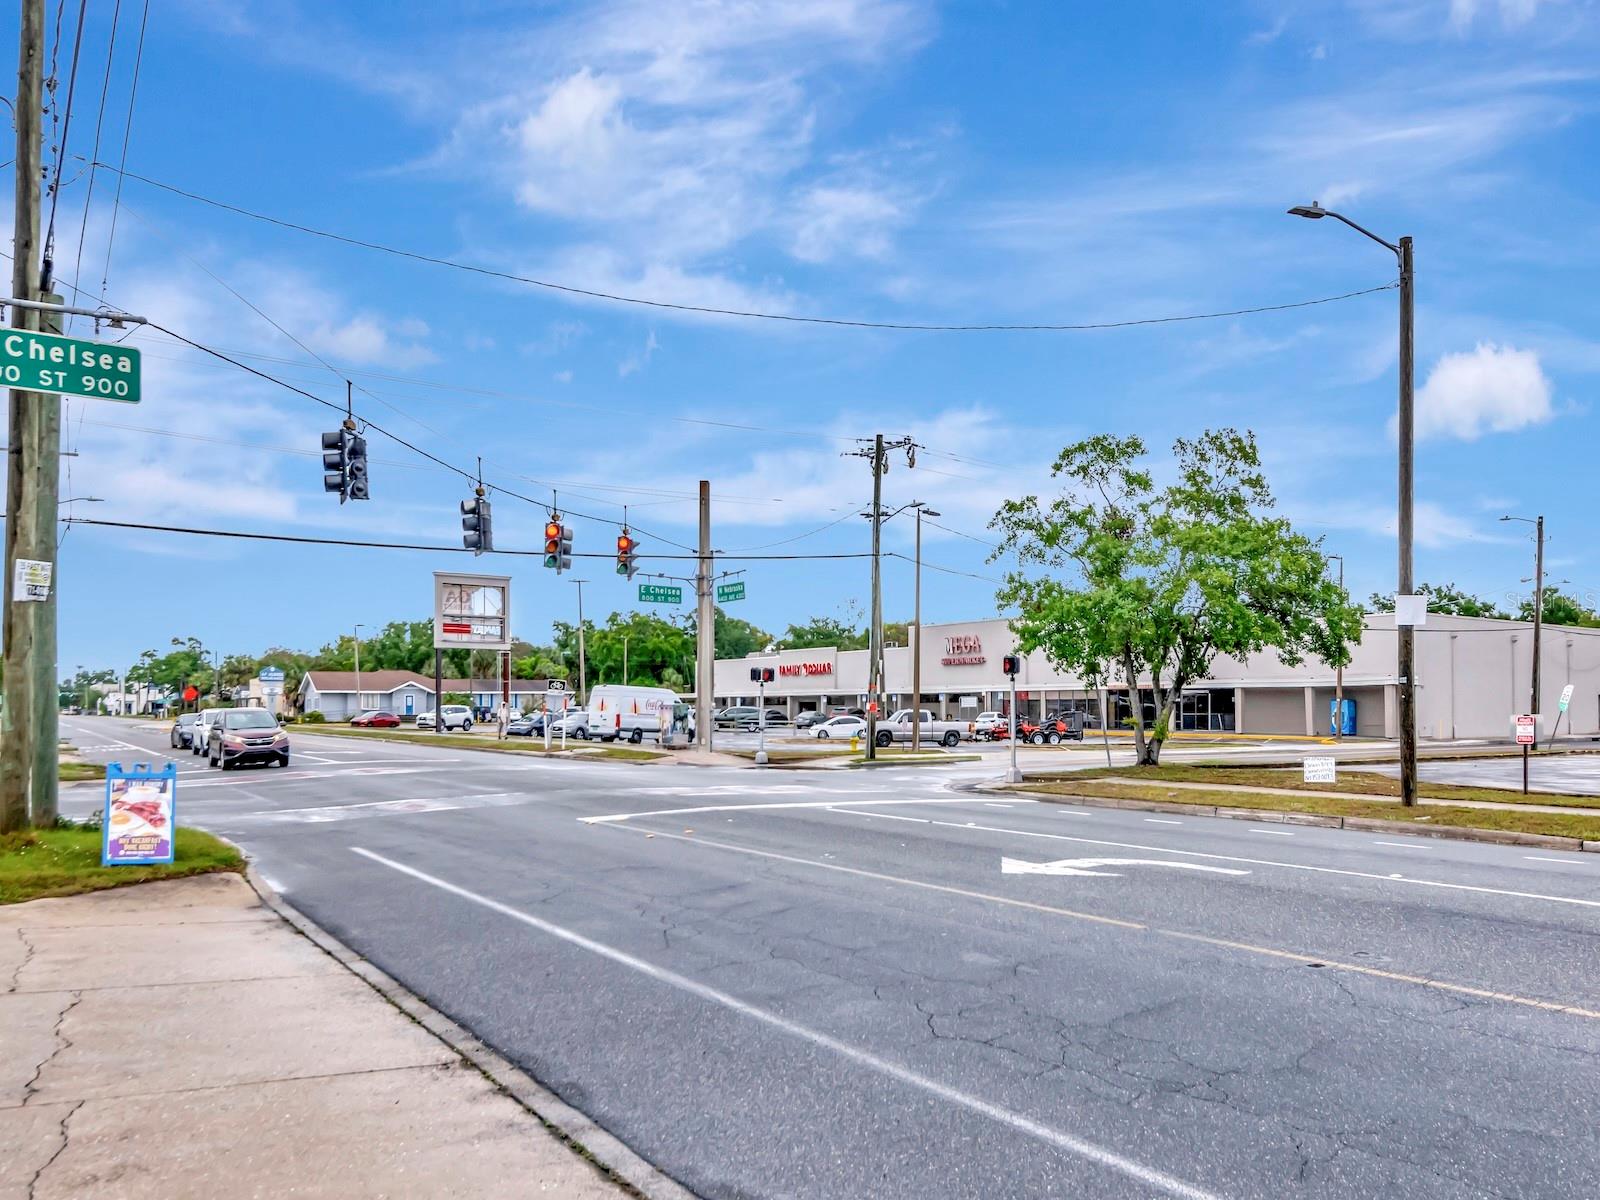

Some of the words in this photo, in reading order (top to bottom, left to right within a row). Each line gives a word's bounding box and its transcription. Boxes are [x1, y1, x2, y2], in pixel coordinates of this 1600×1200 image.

[5, 335, 132, 373] Chelsea
[0, 365, 21, 382] 0
[39, 369, 67, 388] ST
[82, 375, 129, 396] 900
[640, 585, 646, 593] E
[649, 586, 680, 595] Chelsea
[944, 635, 982, 655] MEGA
[779, 664, 801, 677] FAMILY
[801, 662, 832, 677] DOLLAR
